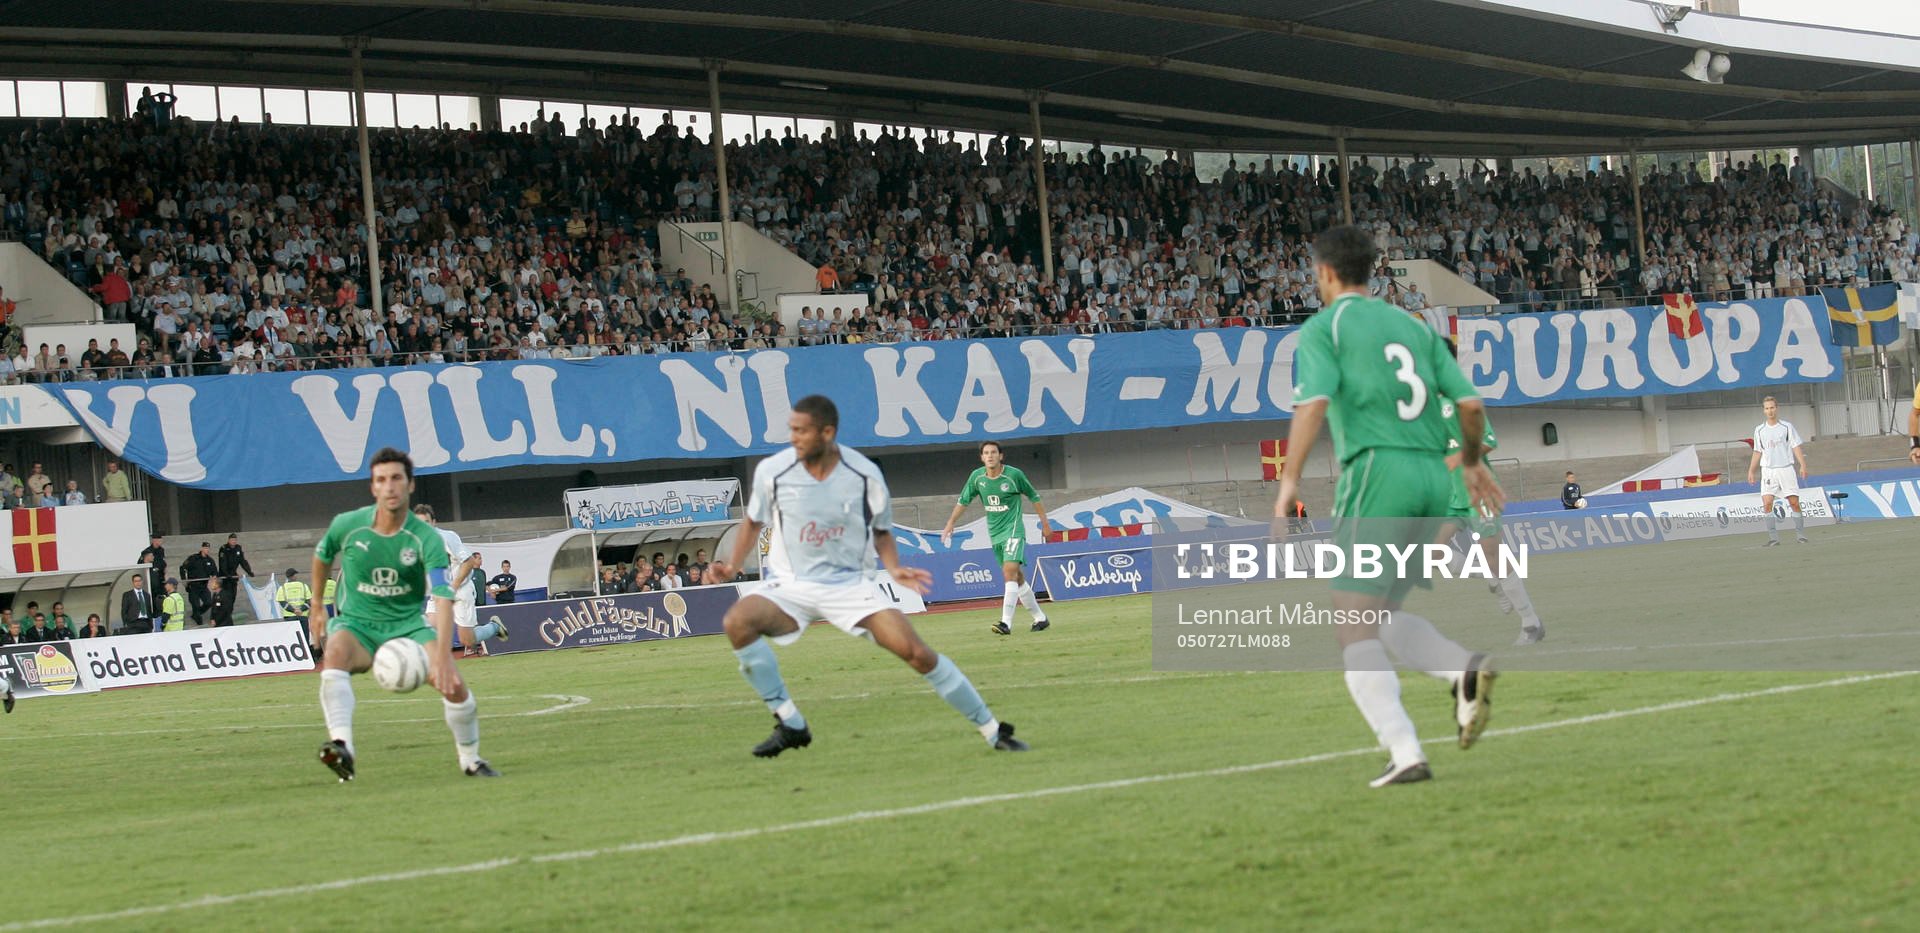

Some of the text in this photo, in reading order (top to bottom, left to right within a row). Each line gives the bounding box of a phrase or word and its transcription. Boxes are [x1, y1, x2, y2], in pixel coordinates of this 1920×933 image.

[62, 383, 206, 483] VI
[291, 365, 616, 474] VILL,
[659, 349, 793, 452] NI
[864, 339, 1095, 437] KAN
[1456, 298, 1834, 400] EUROPA
[1383, 342, 1427, 421] 3
[597, 490, 719, 523] MALMÖ FF
[1671, 510, 1711, 521] HILDING
[1502, 511, 1656, 553] lfisk-ALTO
[1676, 519, 1714, 530] ANDERS
[1733, 515, 1765, 525] ANDER
[1005, 538, 1020, 554] 17
[952, 569, 993, 584] SIGNS
[1060, 560, 1142, 592] Hedbergs
[357, 581, 413, 597] HONDA
[86, 646, 186, 679] öderna
[190, 630, 309, 670] Edstrand
